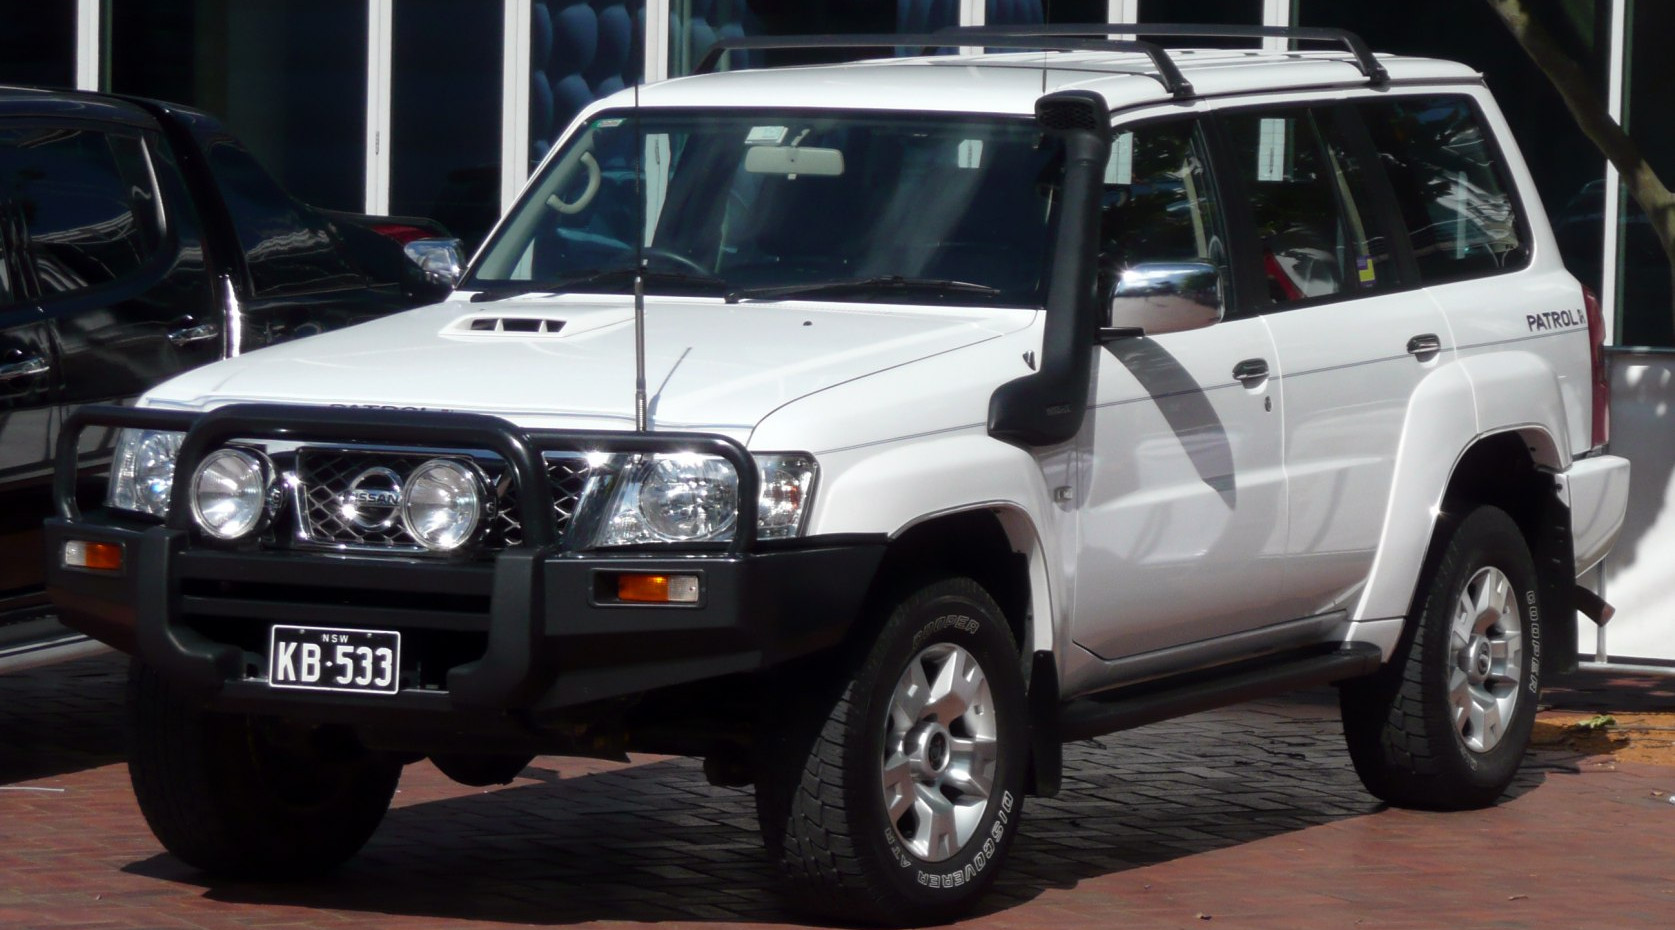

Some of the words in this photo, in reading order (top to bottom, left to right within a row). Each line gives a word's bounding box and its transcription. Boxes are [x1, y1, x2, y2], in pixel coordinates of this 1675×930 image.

[1526, 309, 1579, 332] PATROL
[321, 633, 349, 644] NSW
[912, 614, 980, 653] COOPER
[1526, 590, 1540, 693] COOPER
[917, 788, 1014, 889] DISCOVERER
